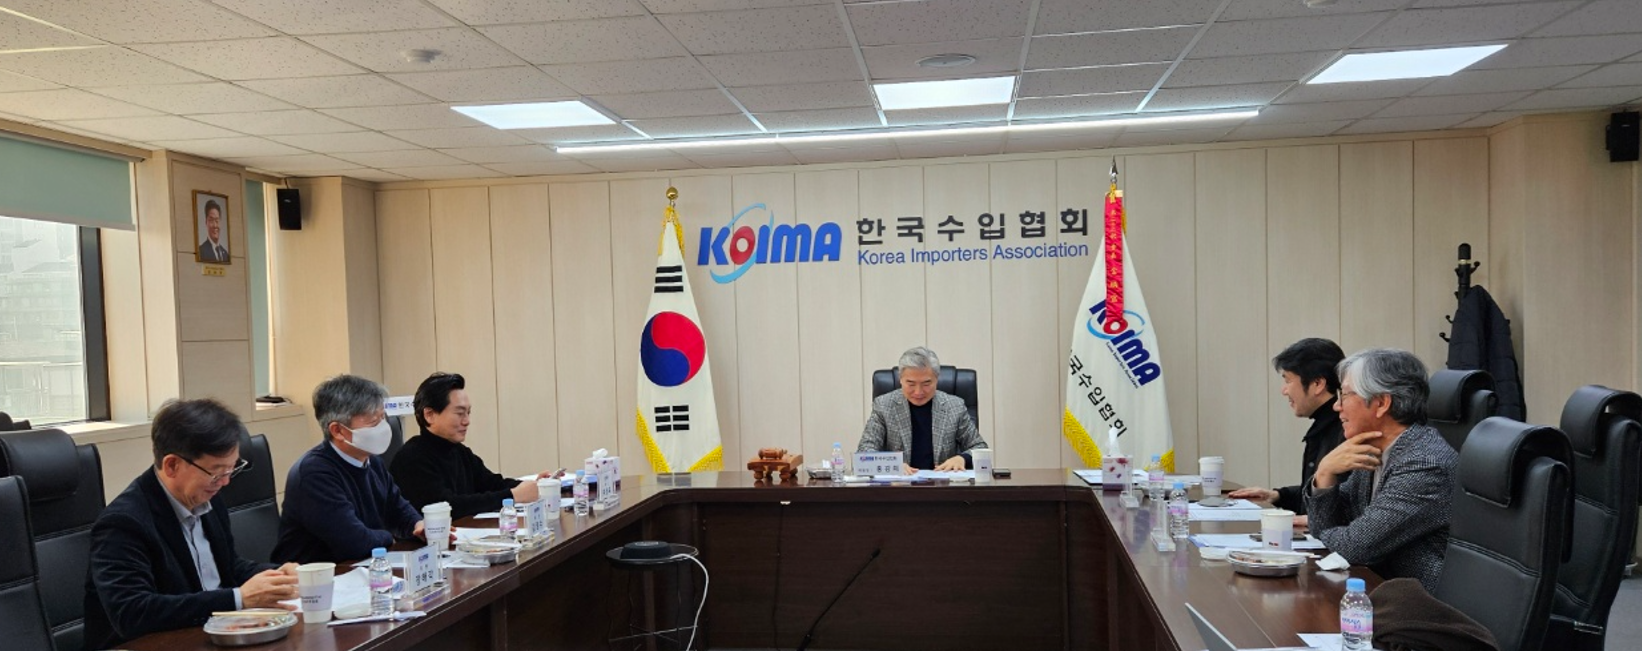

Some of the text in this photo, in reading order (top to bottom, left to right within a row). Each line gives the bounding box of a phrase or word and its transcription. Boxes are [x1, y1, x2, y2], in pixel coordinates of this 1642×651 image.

[697, 221, 842, 267] KOIMA
[856, 208, 1089, 246] 한국수입협회
[857, 242, 1089, 265] Korea Importers Association
[1069, 350, 1127, 437] 국수입협회
